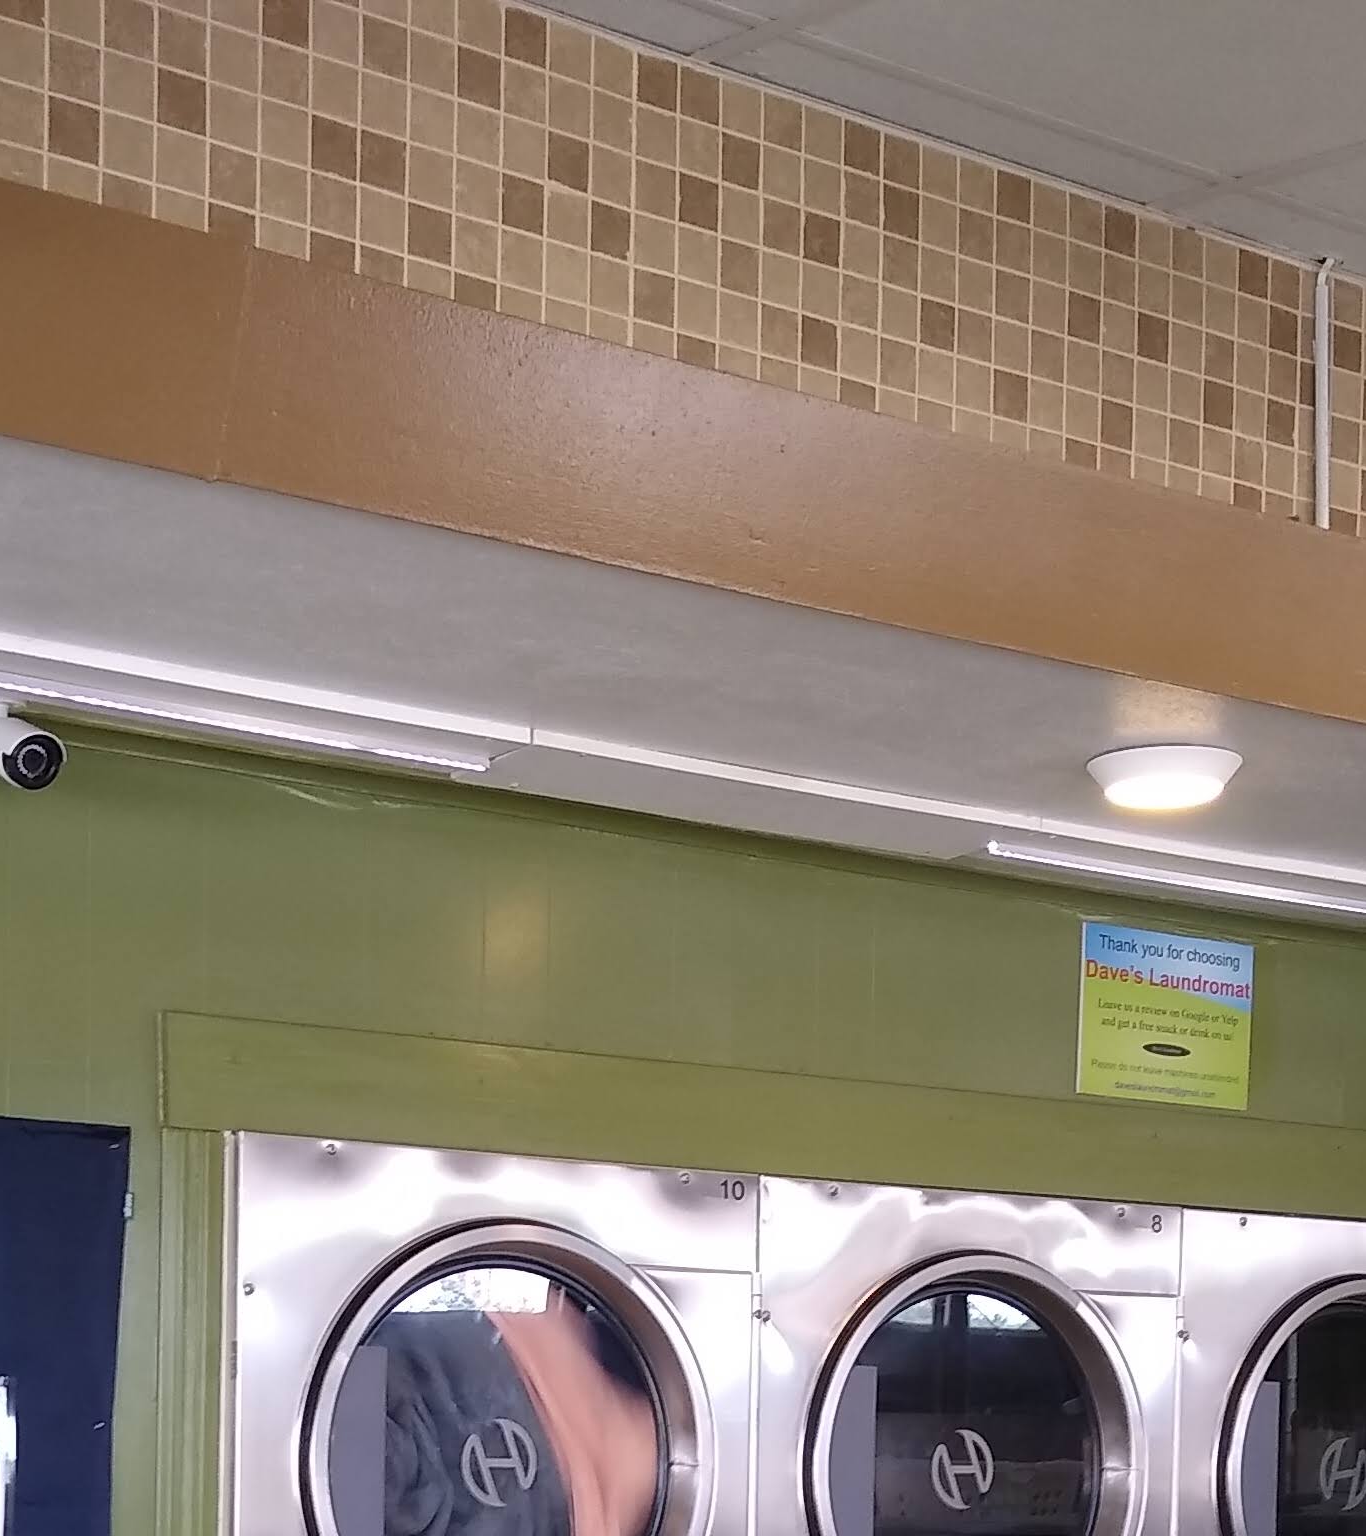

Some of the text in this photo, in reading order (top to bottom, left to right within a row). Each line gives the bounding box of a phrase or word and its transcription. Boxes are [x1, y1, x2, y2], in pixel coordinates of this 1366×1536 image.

[1099, 933, 1241, 972] Thank you for choosing
[1086, 959, 1252, 999] Dave's Laundromat
[1098, 998, 1122, 1011] Leave
[1181, 1009, 1210, 1023] Google
[1221, 1014, 1239, 1027] Yelp
[1101, 1017, 1116, 1027] and
[1117, 1019, 1130, 1030] get
[1138, 1020, 1154, 1032] free
[1190, 1026, 1210, 1038] drink
[719, 1179, 747, 1202] 10
[1150, 1213, 1164, 1234] 8
